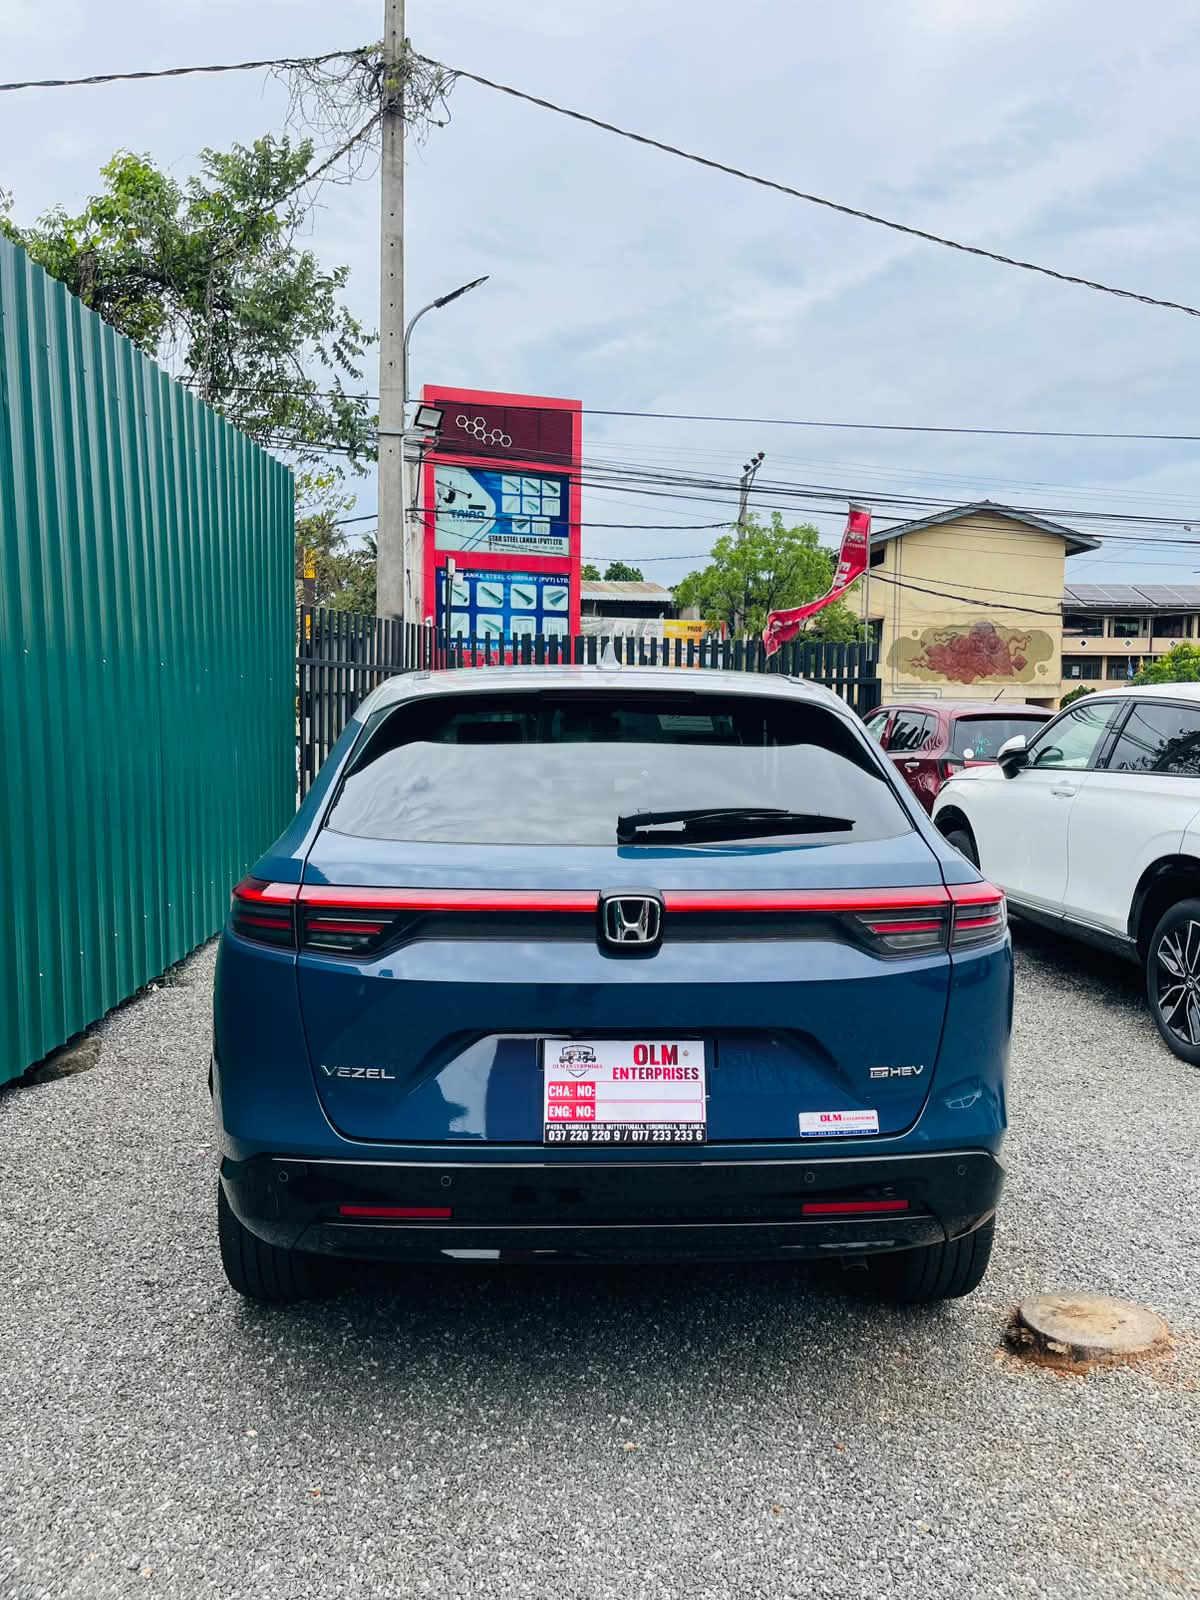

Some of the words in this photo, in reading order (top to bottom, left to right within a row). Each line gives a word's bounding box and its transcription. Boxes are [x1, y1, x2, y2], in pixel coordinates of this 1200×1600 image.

[633, 1044, 678, 1066] OLM
[320, 1065, 396, 1079] VEZEL
[612, 1067, 699, 1080] ENTERPRISES
[548, 1085, 573, 1097] CHA:
[577, 1085, 595, 1097] NO:
[548, 1105, 573, 1117] ENG:
[576, 1105, 595, 1117] NO:
[820, 1114, 842, 1122] OLM
[548, 1131, 567, 1141] 037
[570, 1131, 588, 1141] 220
[592, 1131, 611, 1141] 220
[613, 1131, 621, 1141] 9
[623, 1131, 629, 1141] /
[631, 1131, 649, 1141] 077
[652, 1131, 671, 1141] 233
[674, 1131, 693, 1141] 233
[696, 1131, 703, 1141] 6
